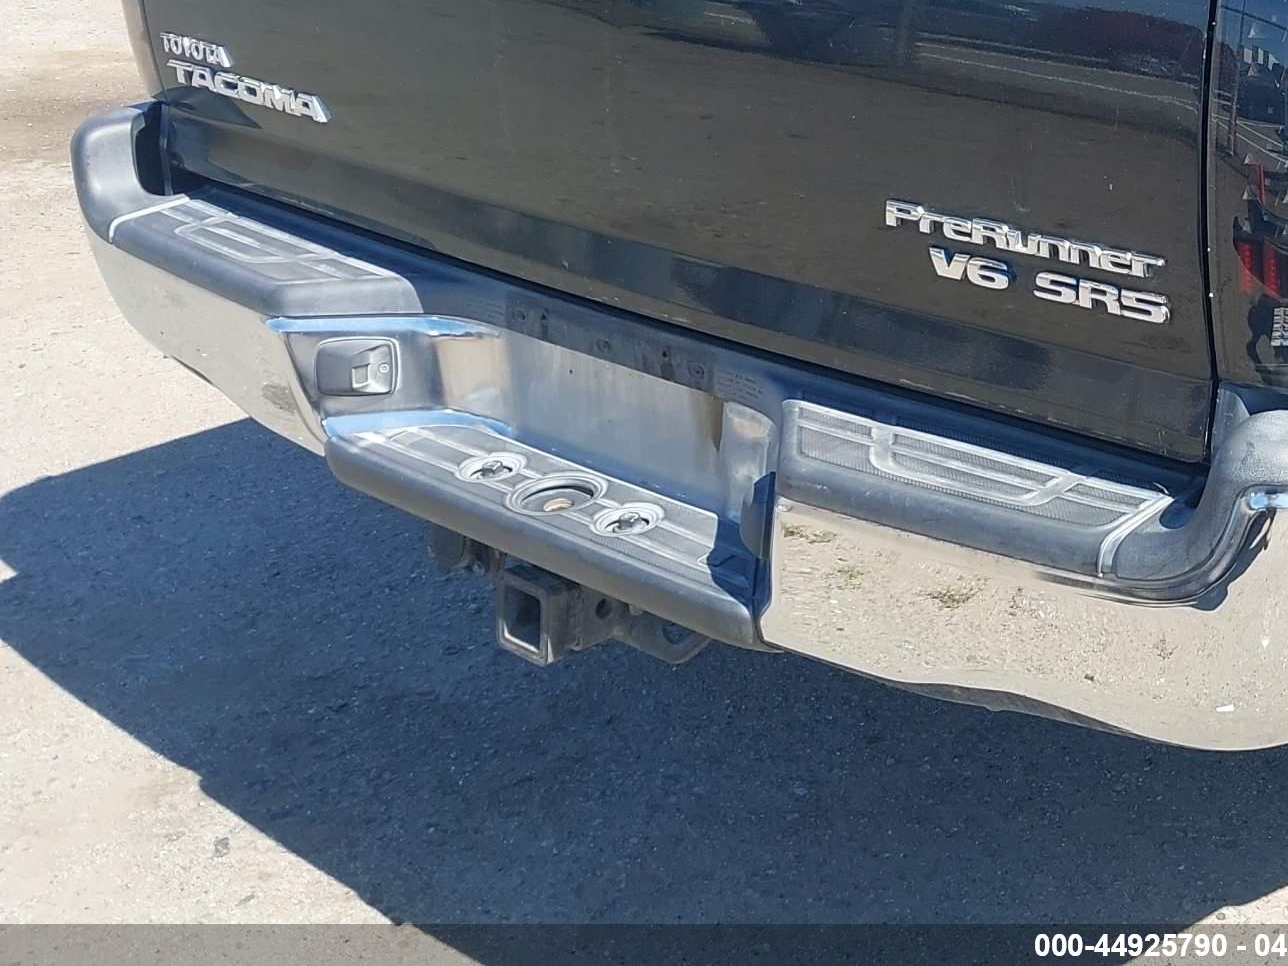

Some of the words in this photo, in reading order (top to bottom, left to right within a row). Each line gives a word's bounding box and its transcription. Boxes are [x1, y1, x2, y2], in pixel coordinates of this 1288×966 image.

[160, 32, 233, 68] TOYOTA
[166, 59, 332, 124] TACOMA
[885, 199, 1166, 278] PreRunner
[928, 246, 1010, 290] V6
